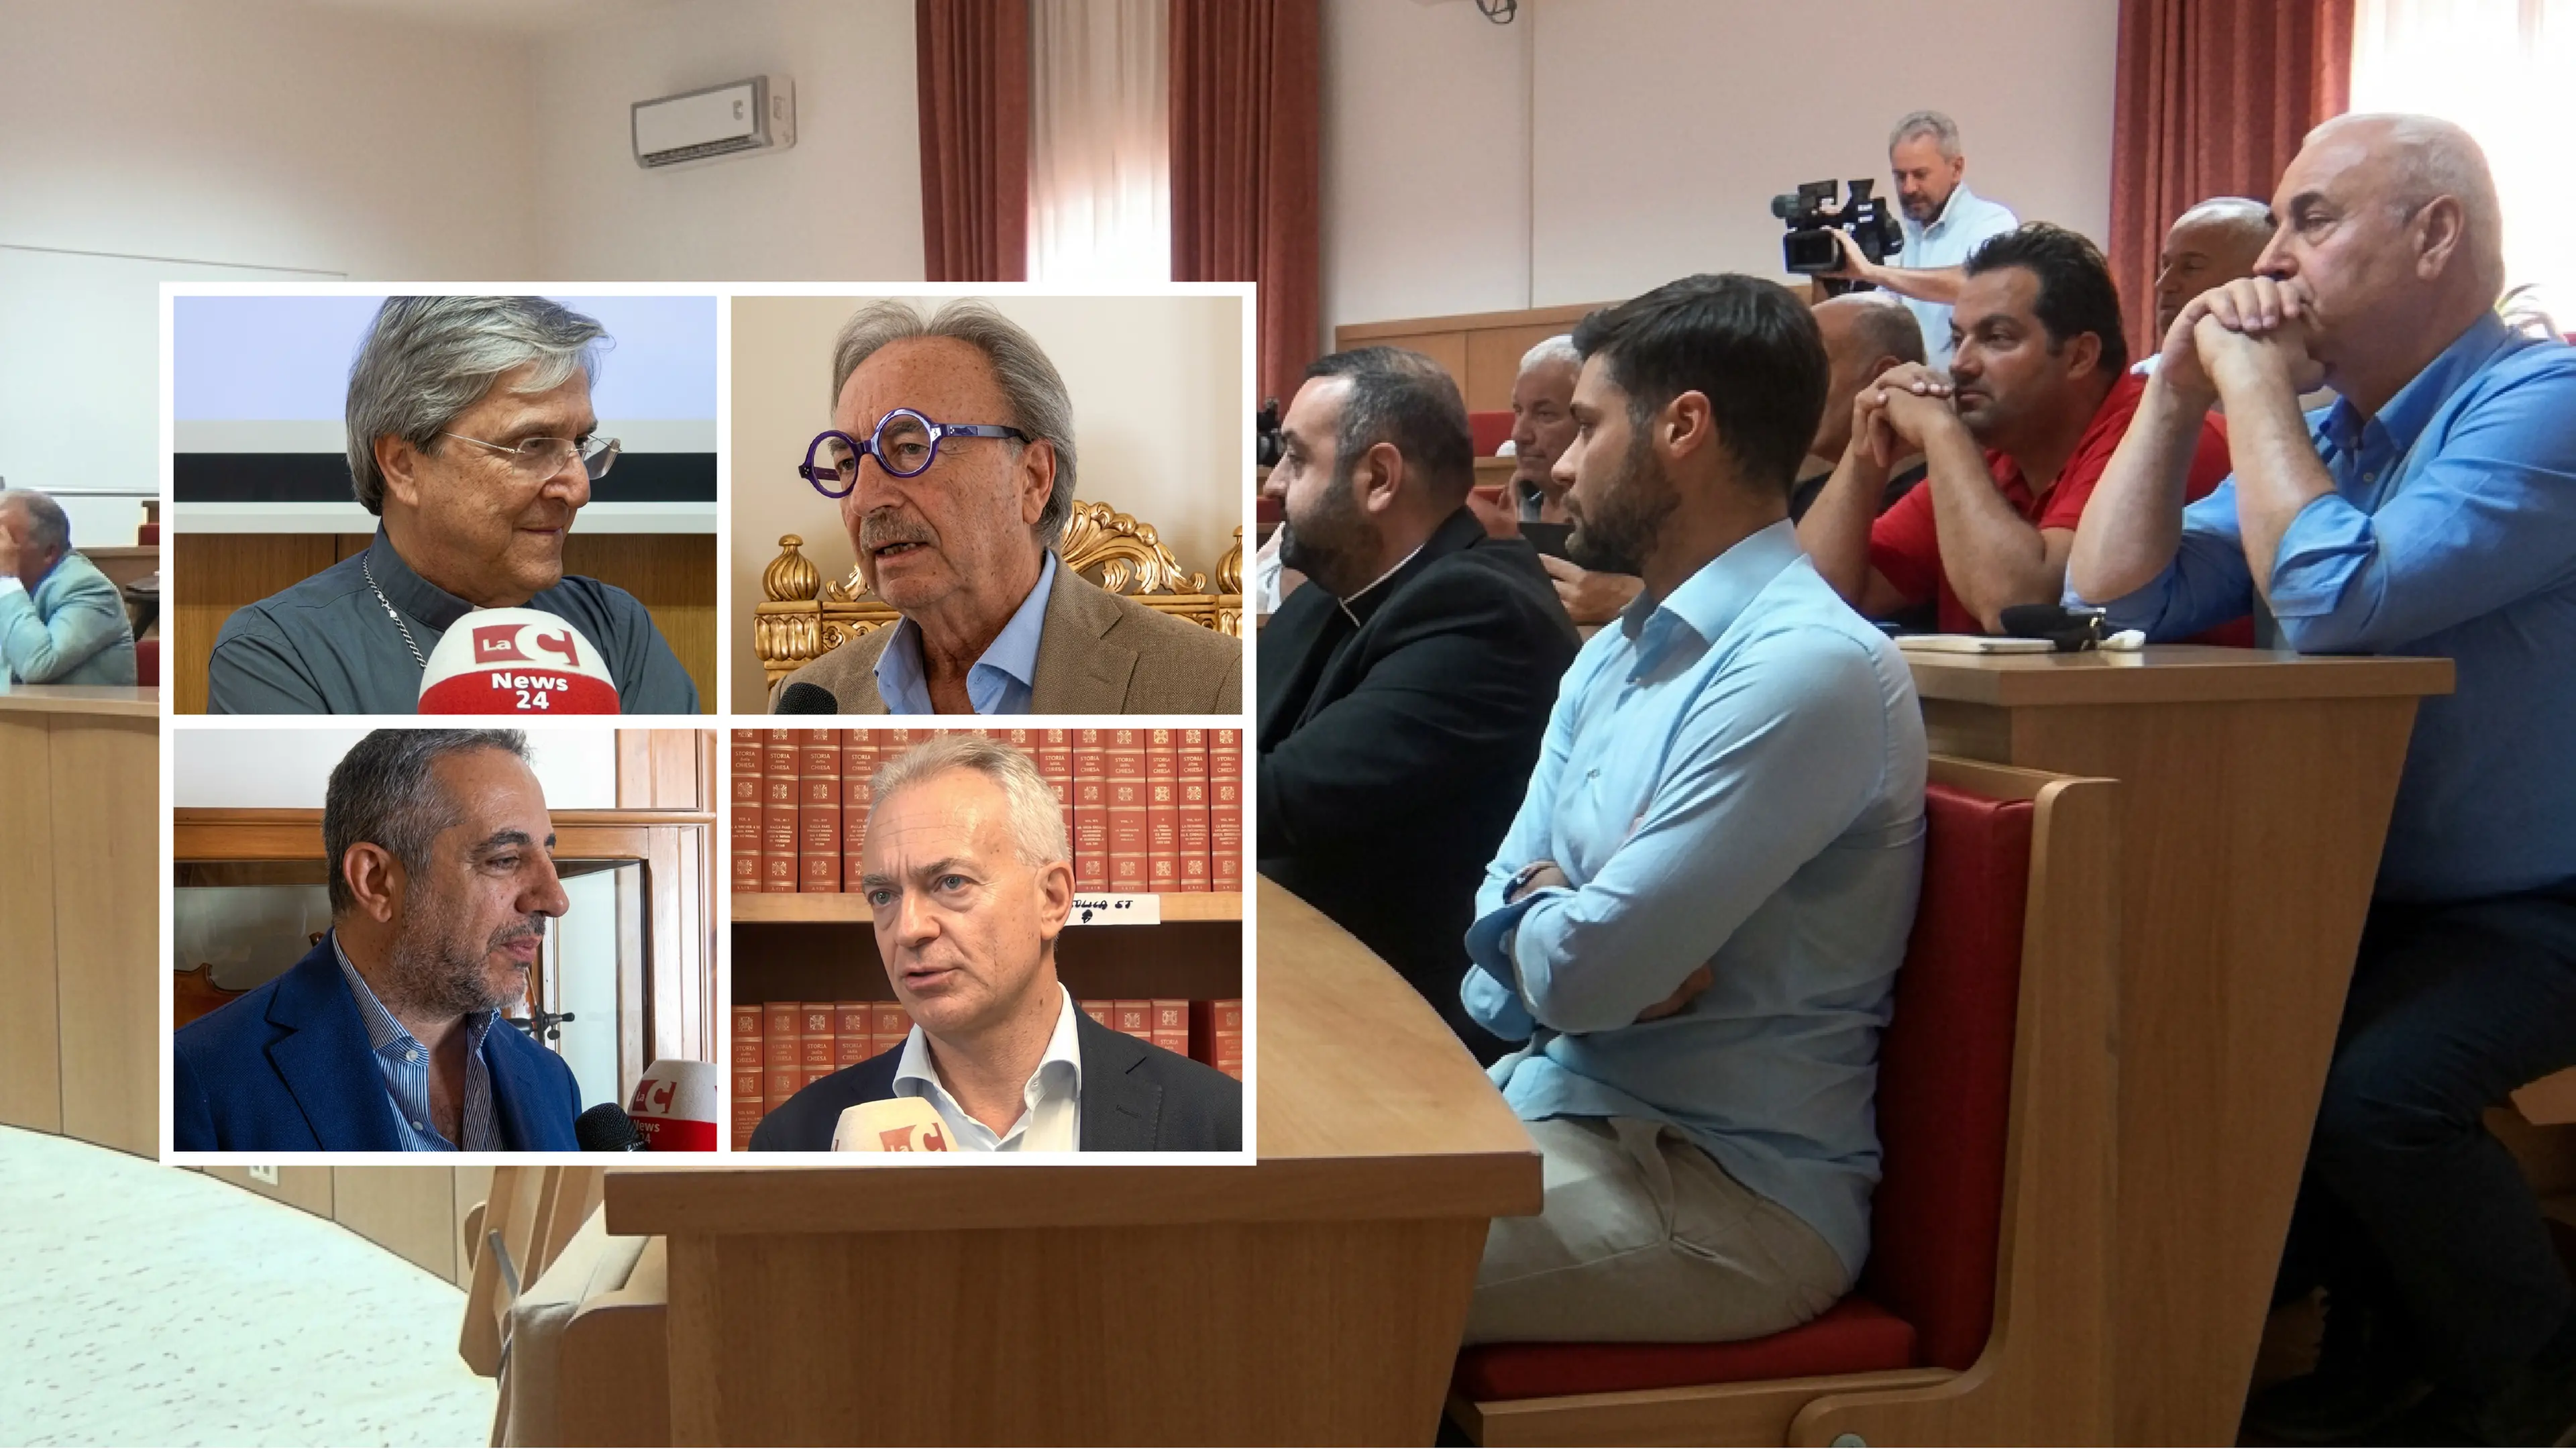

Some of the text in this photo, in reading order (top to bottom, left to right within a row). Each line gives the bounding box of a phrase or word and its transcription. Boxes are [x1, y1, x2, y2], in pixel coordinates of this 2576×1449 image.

[483, 639, 511, 651] La
[492, 673, 568, 691] News
[516, 691, 549, 709] 24
[634, 1120, 660, 1132] News
